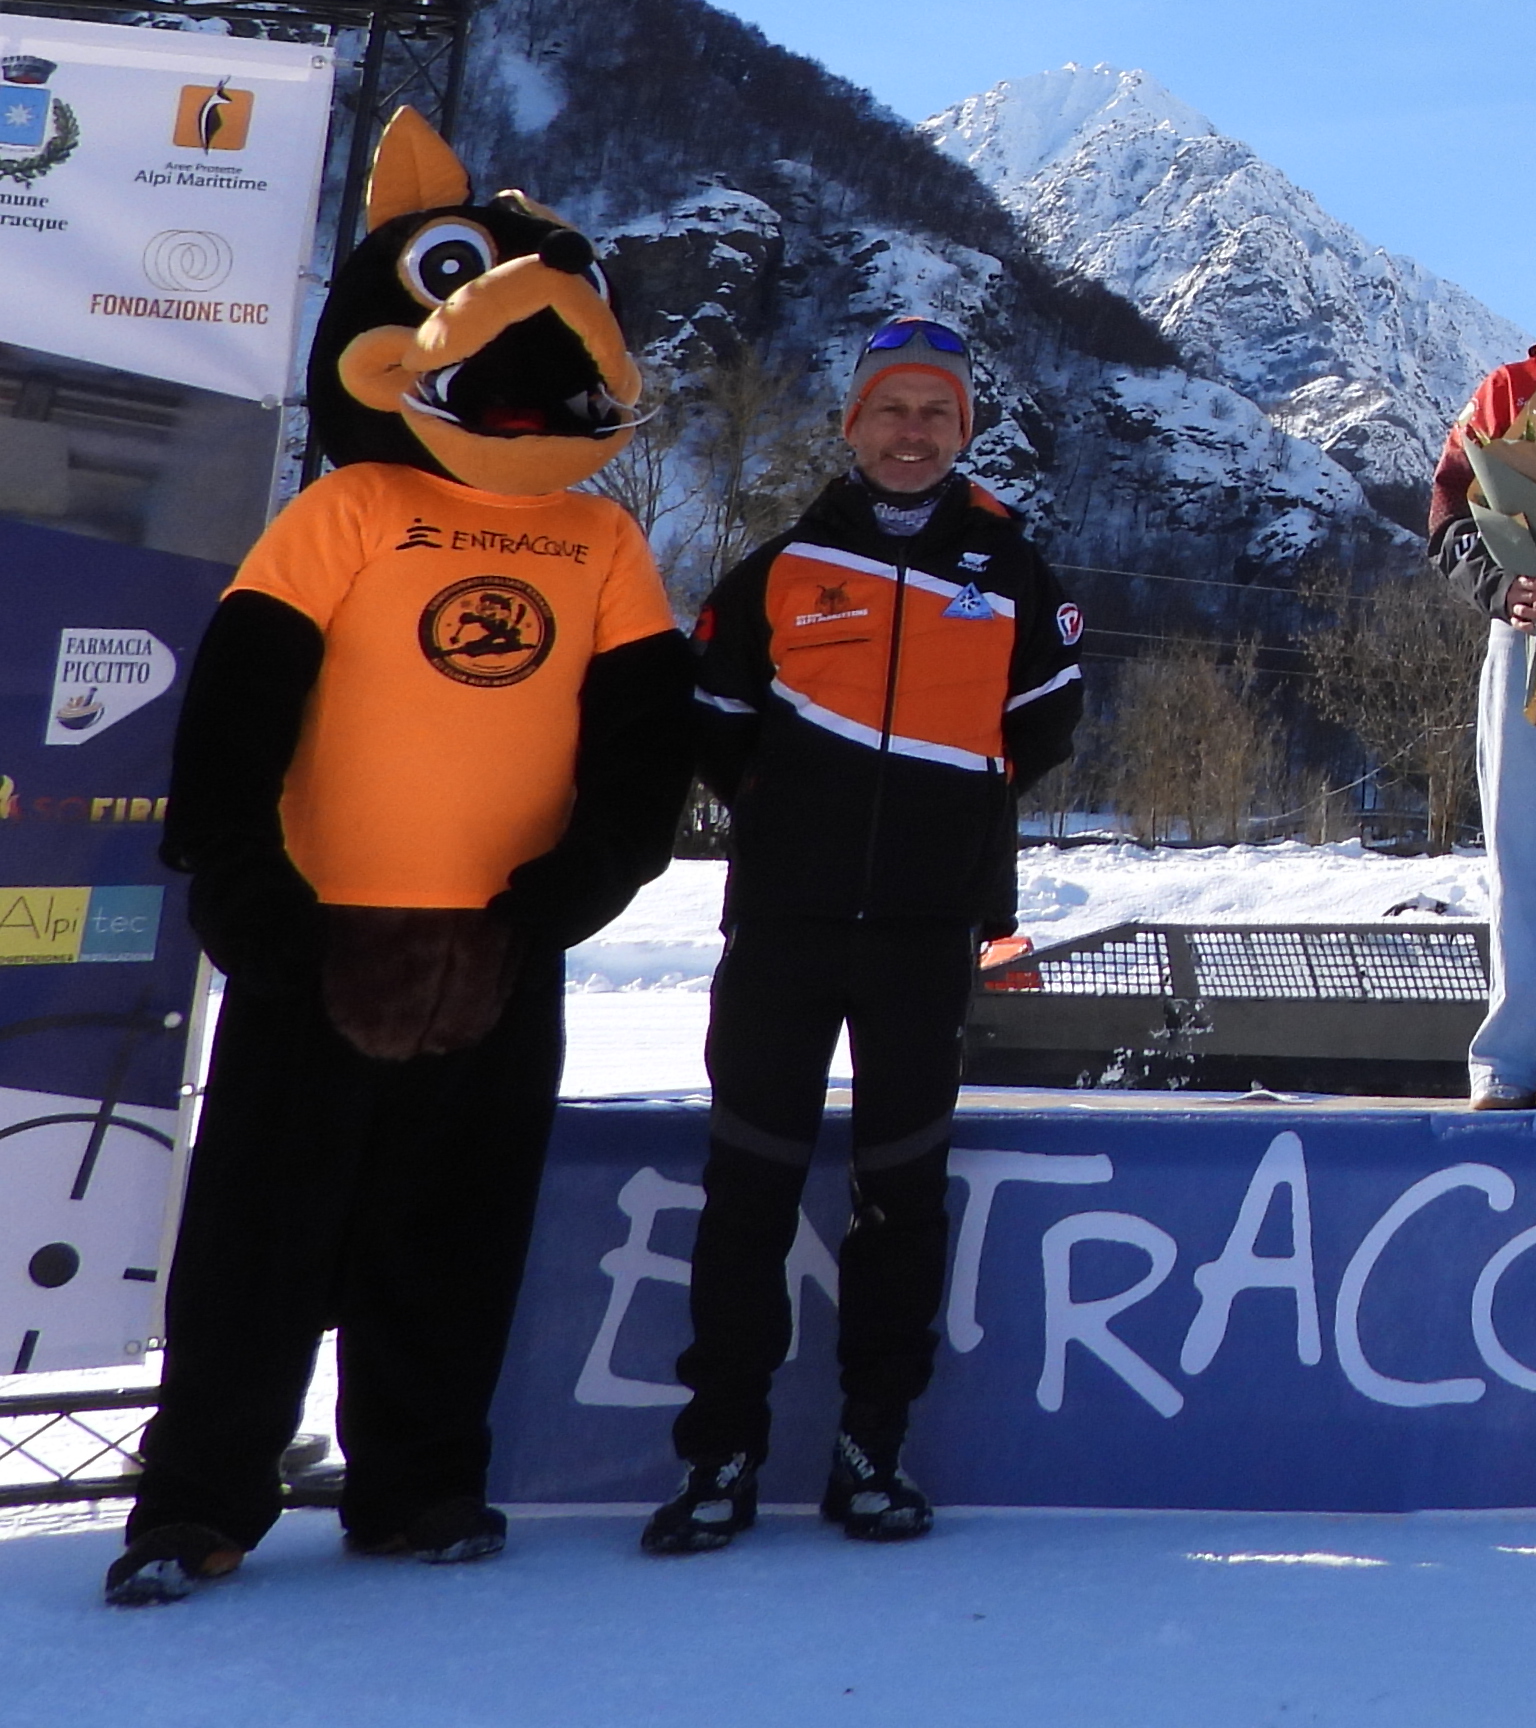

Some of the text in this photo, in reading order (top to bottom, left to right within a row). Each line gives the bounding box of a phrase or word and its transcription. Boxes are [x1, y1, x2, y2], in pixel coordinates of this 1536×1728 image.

[134, 170, 268, 191] Alpi Marittime
[90, 293, 269, 325] FONDAZIONE CRC
[452, 529, 589, 564] ENTRACQUE
[65, 636, 153, 656] FARMACIA
[61, 660, 151, 685] PICCITTO
